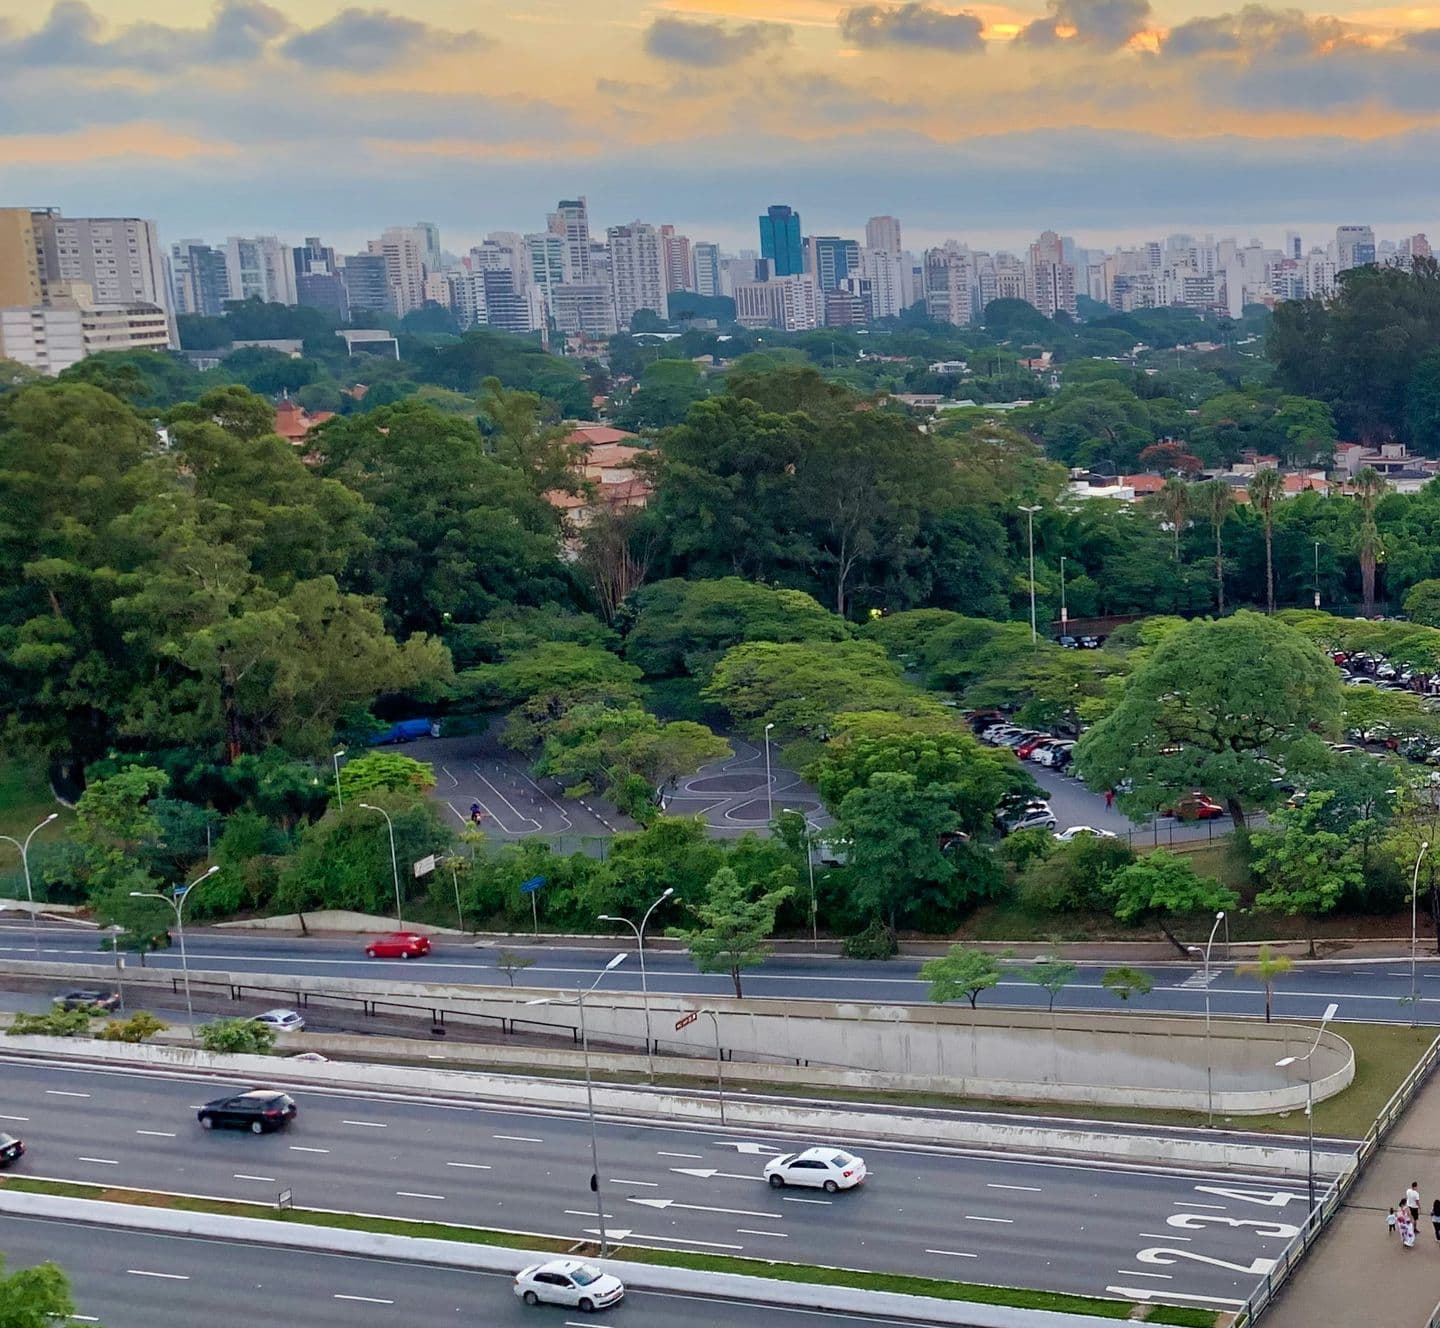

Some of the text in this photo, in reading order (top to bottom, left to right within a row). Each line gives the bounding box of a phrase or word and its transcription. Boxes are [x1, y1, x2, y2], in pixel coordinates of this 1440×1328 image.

[1194, 1185, 1327, 1206] 4
[1166, 1213, 1300, 1237] 3
[1136, 1247, 1277, 1274] 2
